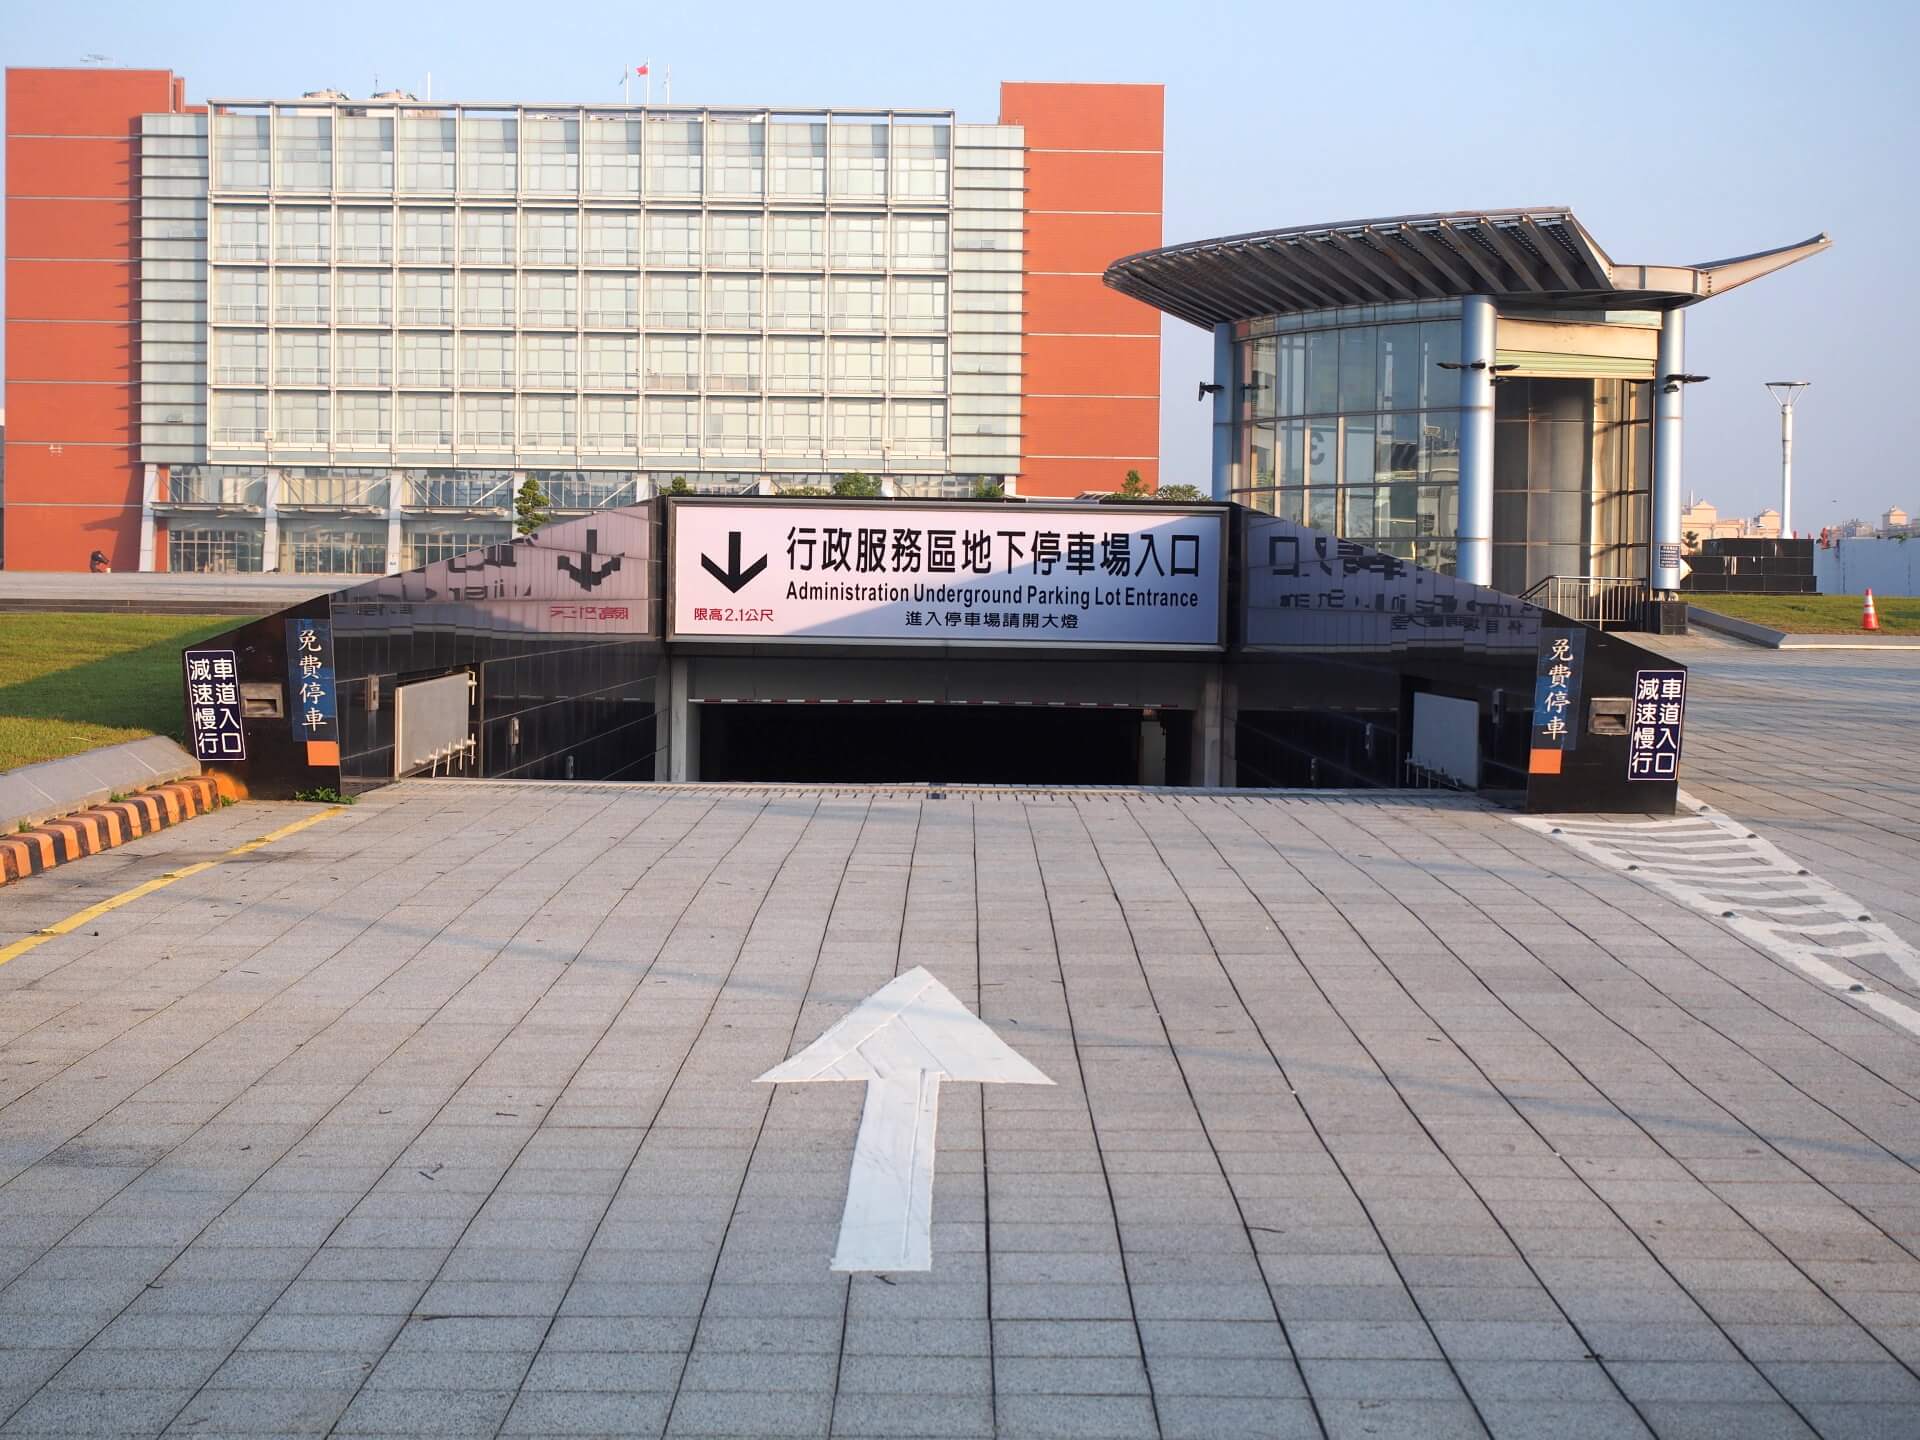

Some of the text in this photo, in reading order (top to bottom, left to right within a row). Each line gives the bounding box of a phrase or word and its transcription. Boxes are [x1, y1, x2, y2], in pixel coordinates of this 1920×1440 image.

[786, 526, 1200, 578] 行政服務區地下停車場入口
[786, 580, 1199, 610] Administration Underground Parking Lot Entrance
[694, 607, 774, 623] 限高2.1公尺
[905, 611, 1080, 629] 進入停車場請開大燈
[190, 659, 219, 754] 減速慢行
[212, 658, 242, 753] 車道入口
[298, 627, 328, 732] 免費停車
[1542, 638, 1574, 741] 免費停車
[1631, 678, 1660, 774] 減速慢行
[1655, 678, 1682, 773] 車道入口
